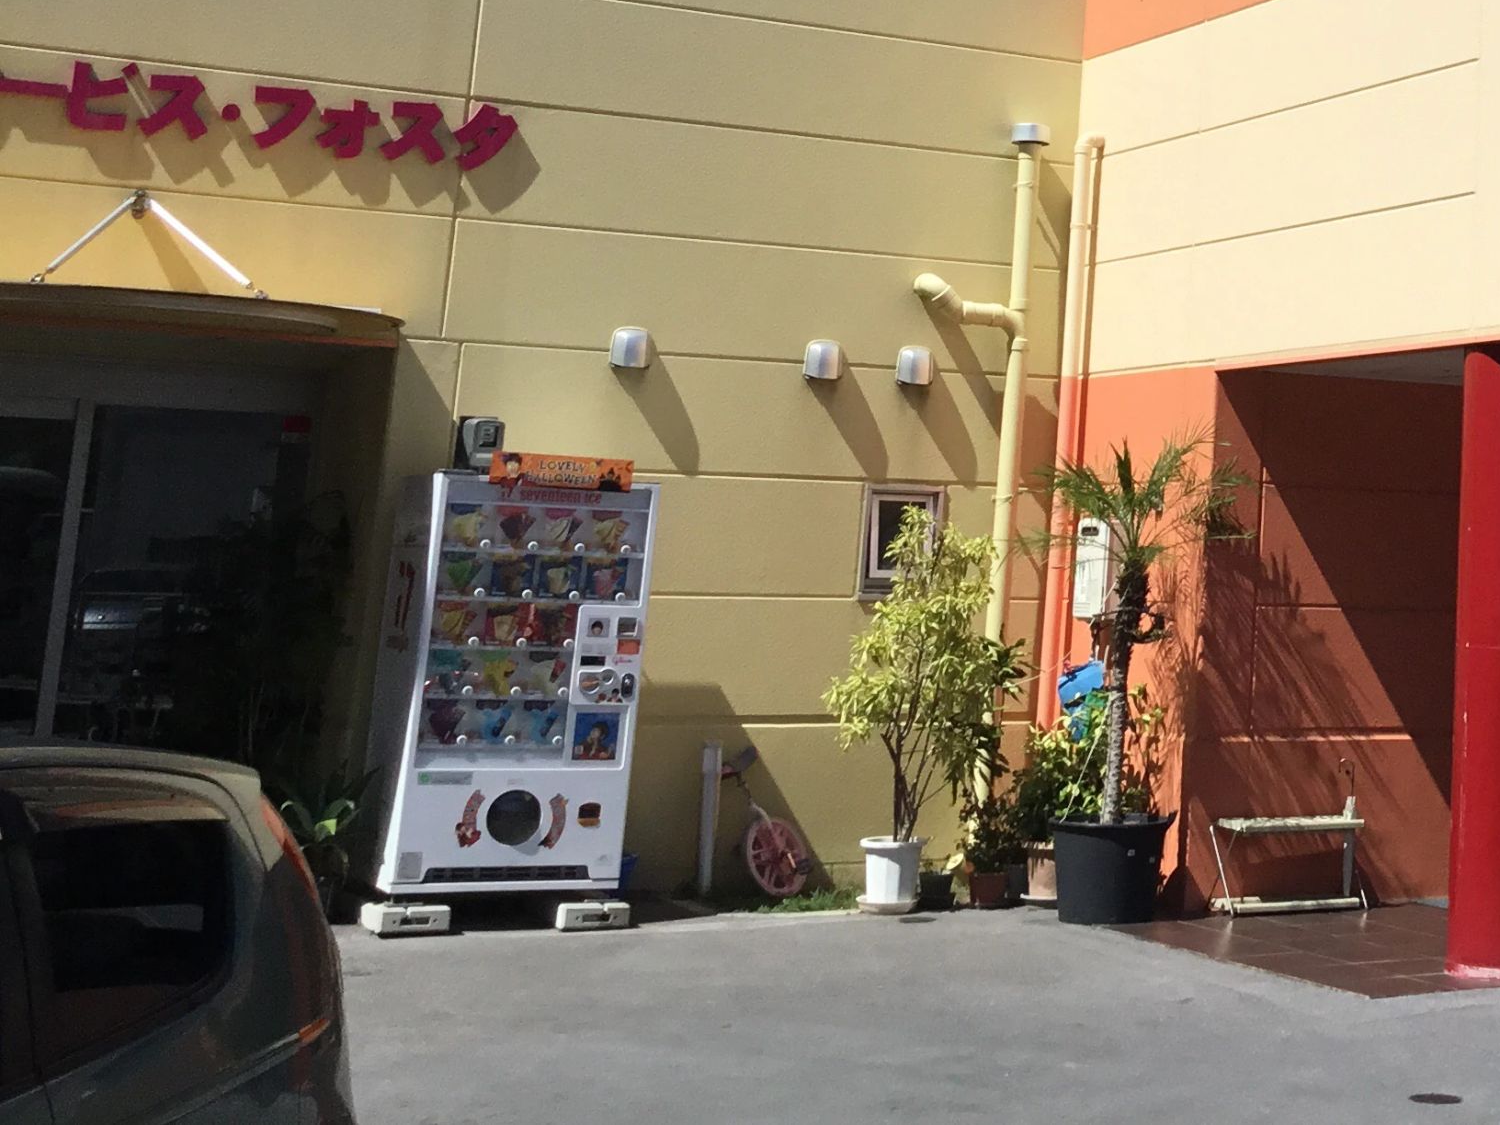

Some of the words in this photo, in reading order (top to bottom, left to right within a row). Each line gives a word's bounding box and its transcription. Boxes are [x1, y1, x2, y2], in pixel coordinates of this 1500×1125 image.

[540, 461, 586, 473] LOVELY
[526, 471, 595, 485] HALLOWEEN
[520, 488, 581, 503] seventeen
